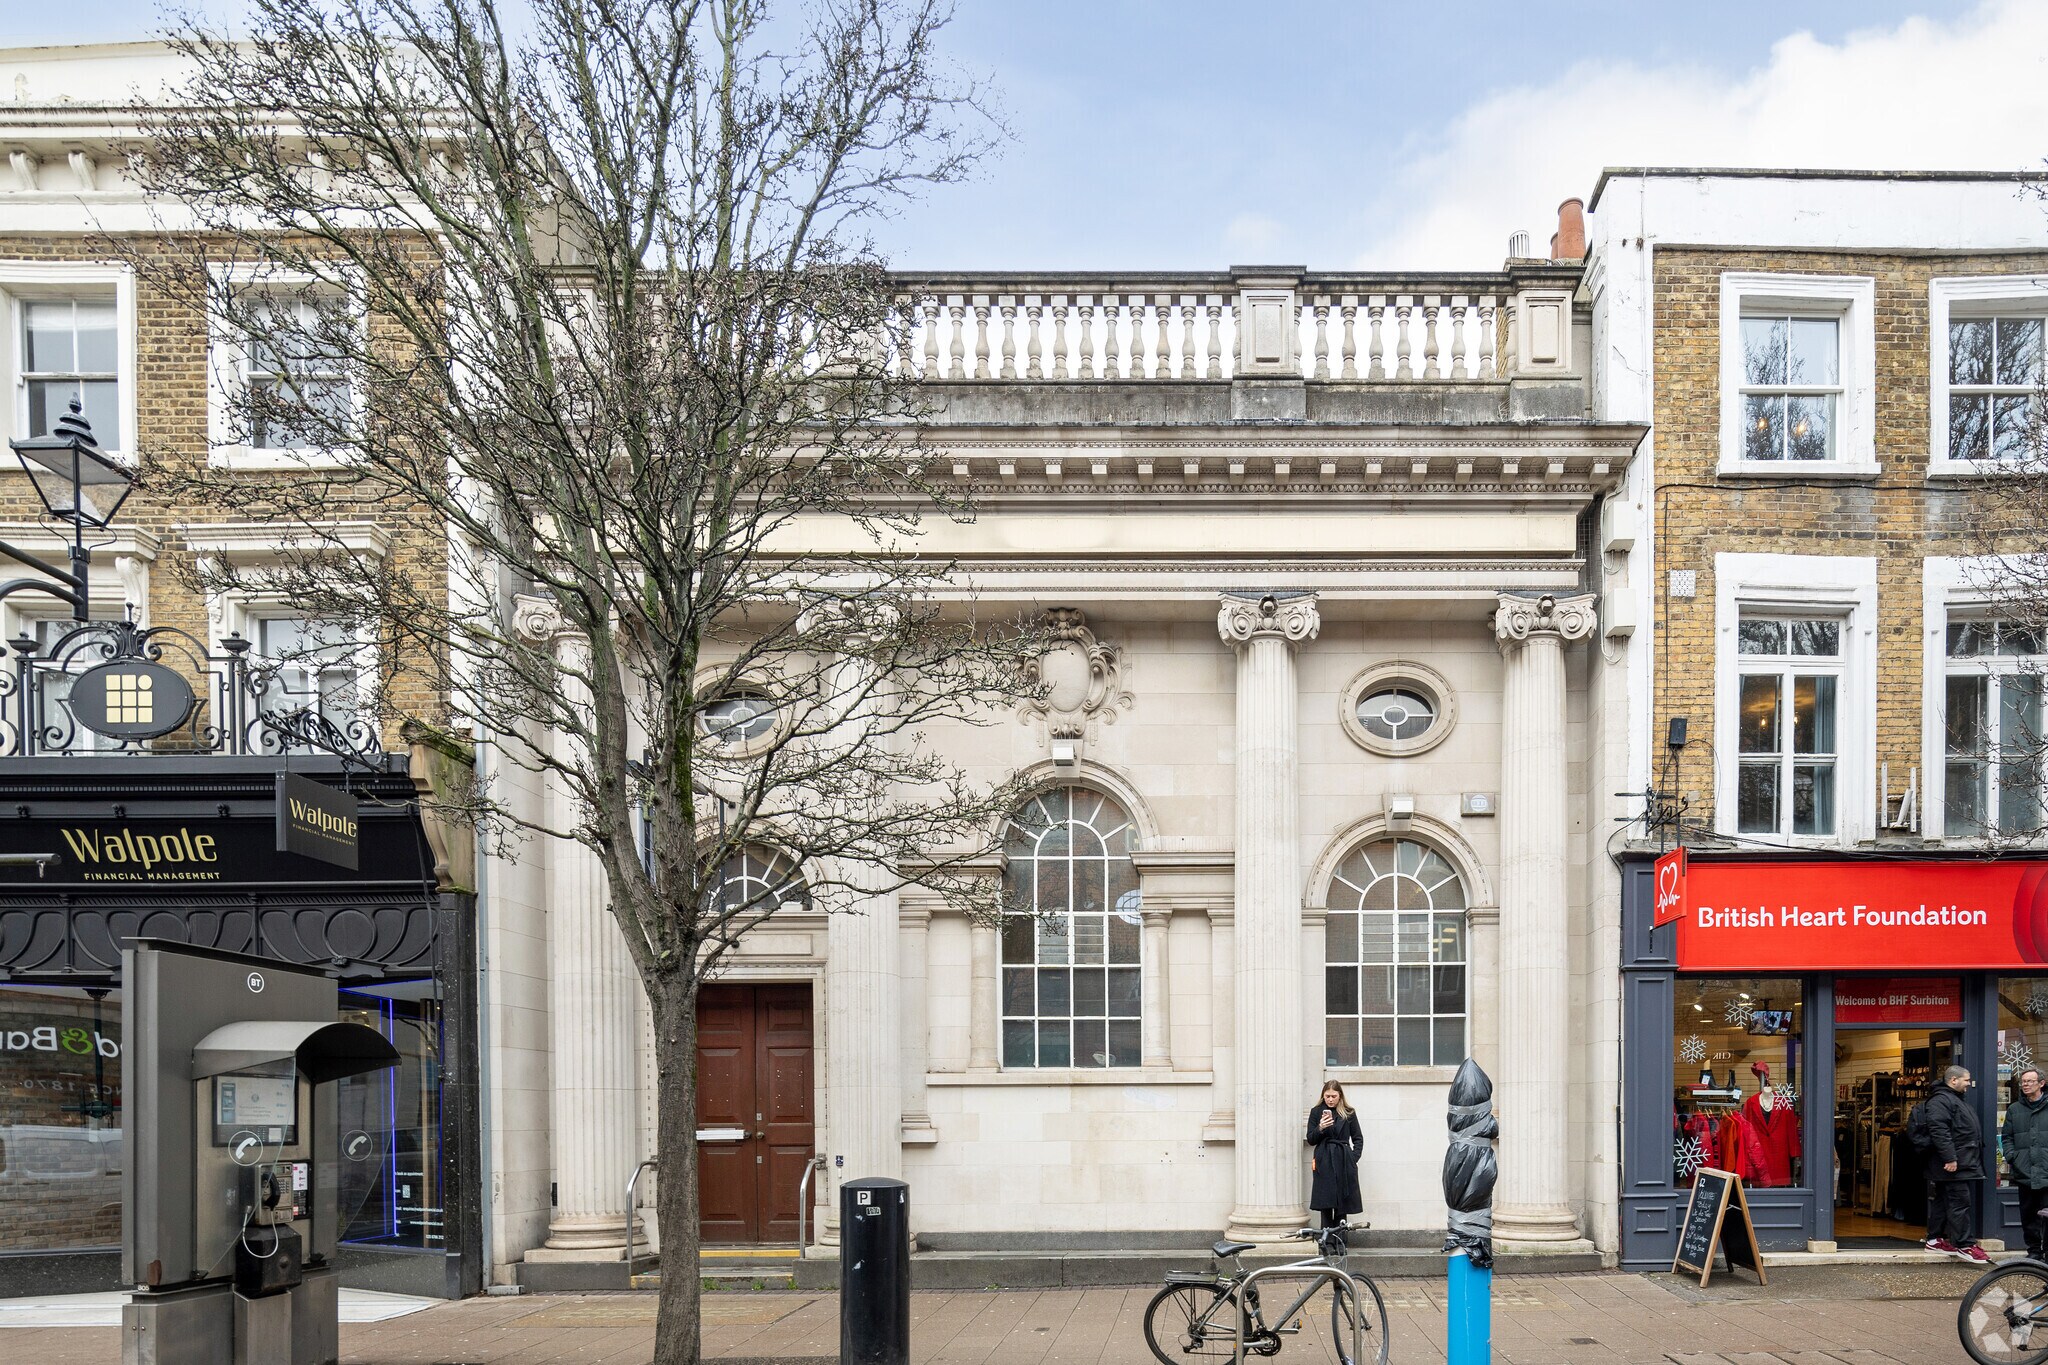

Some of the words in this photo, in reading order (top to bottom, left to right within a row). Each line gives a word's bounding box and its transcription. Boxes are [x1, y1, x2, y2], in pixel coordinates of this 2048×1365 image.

[289, 797, 358, 838] Walpole
[292, 823, 321, 836] FINANCIAL
[321, 833, 355, 847] MANAGEMENT
[60, 827, 218, 870] Walpole
[84, 872, 143, 881] FINANCIAL
[147, 871, 221, 880] MANAGEMENT
[1697, 906, 1774, 928] British
[1781, 906, 1847, 927] Heart
[1853, 905, 1987, 926] Foundation
[250, 977, 262, 988] BT
[1835, 995, 1876, 1006] Welcome
[1878, 995, 1887, 1006] to
[1889, 995, 1909, 1006] BHF
[1910, 994, 1949, 1006] Surbiton
[860, 1193, 868, 1204] P
